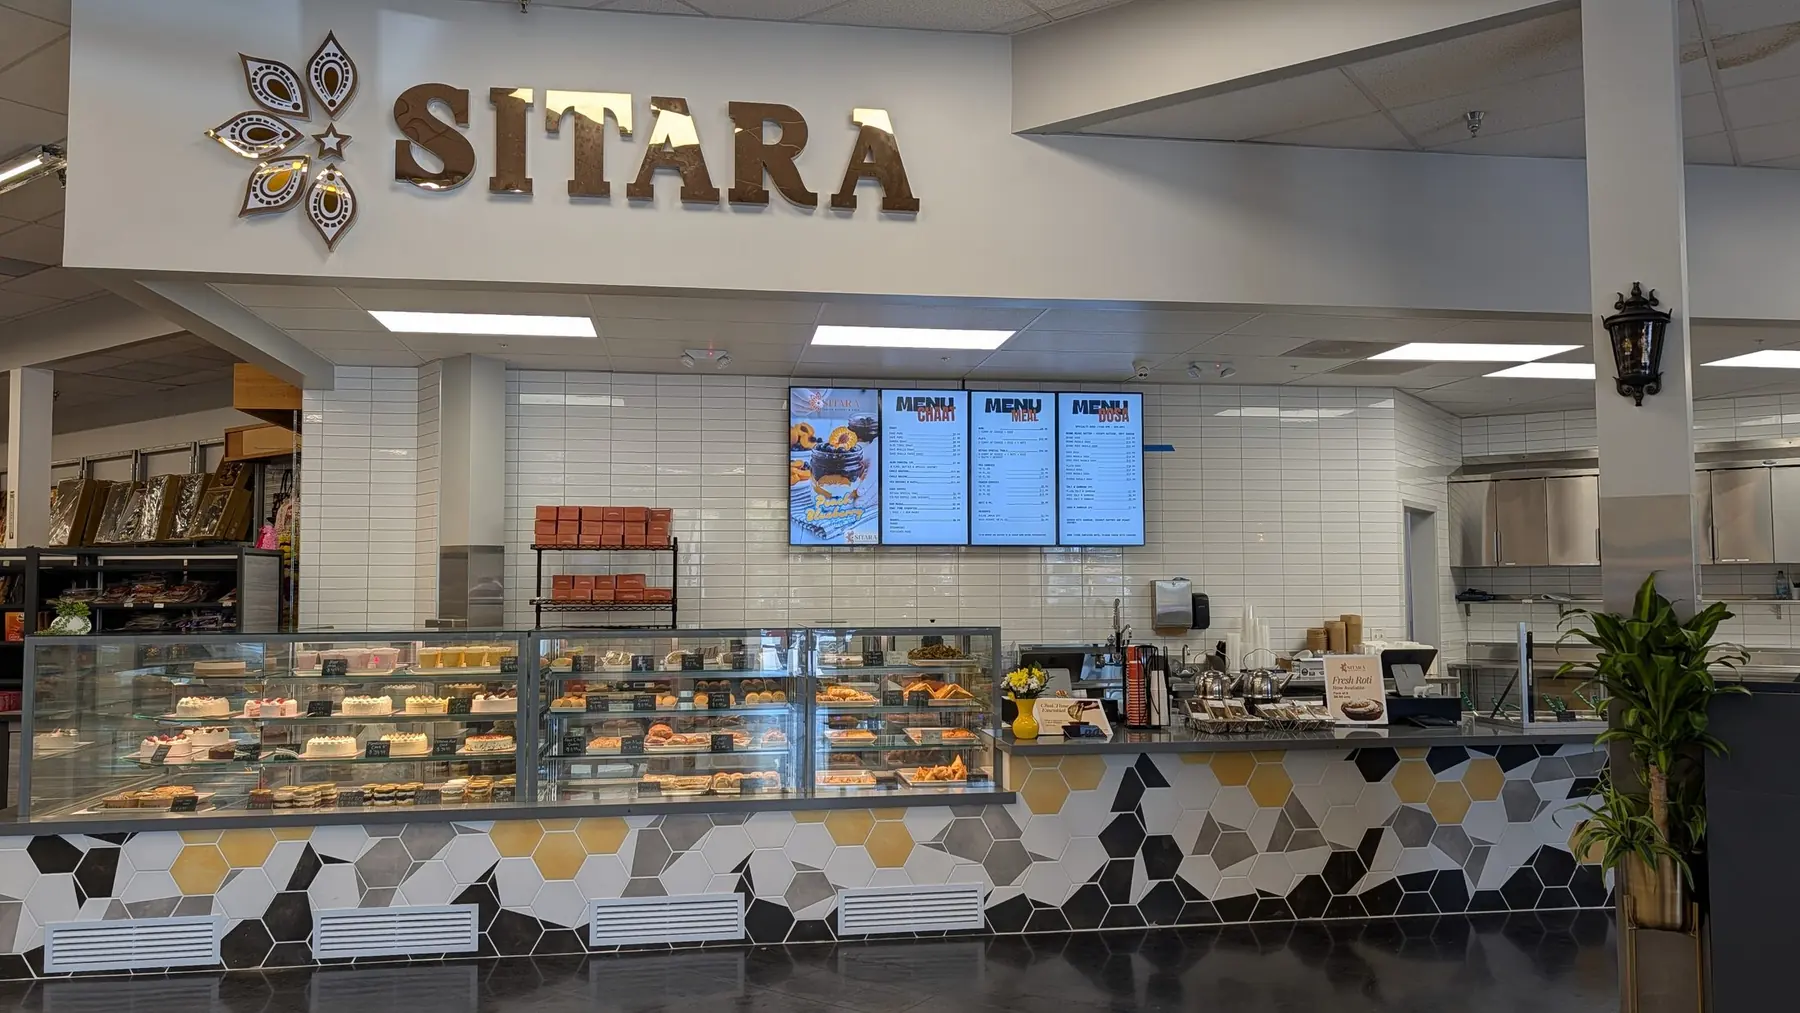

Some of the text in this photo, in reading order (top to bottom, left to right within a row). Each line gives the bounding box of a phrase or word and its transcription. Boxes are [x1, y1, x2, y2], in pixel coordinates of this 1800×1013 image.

[393, 82, 922, 214] SITARA
[896, 396, 956, 412] MENU
[985, 398, 1042, 413] MENU
[1072, 399, 1129, 415] MENU
[917, 406, 956, 422] CHAAT
[1011, 408, 1039, 422] MEAL
[1098, 408, 1130, 423] DOSA
[814, 494, 854, 507] Peach
[806, 507, 864, 522] Blueberry
[1332, 675, 1373, 685] Fresh Roti
